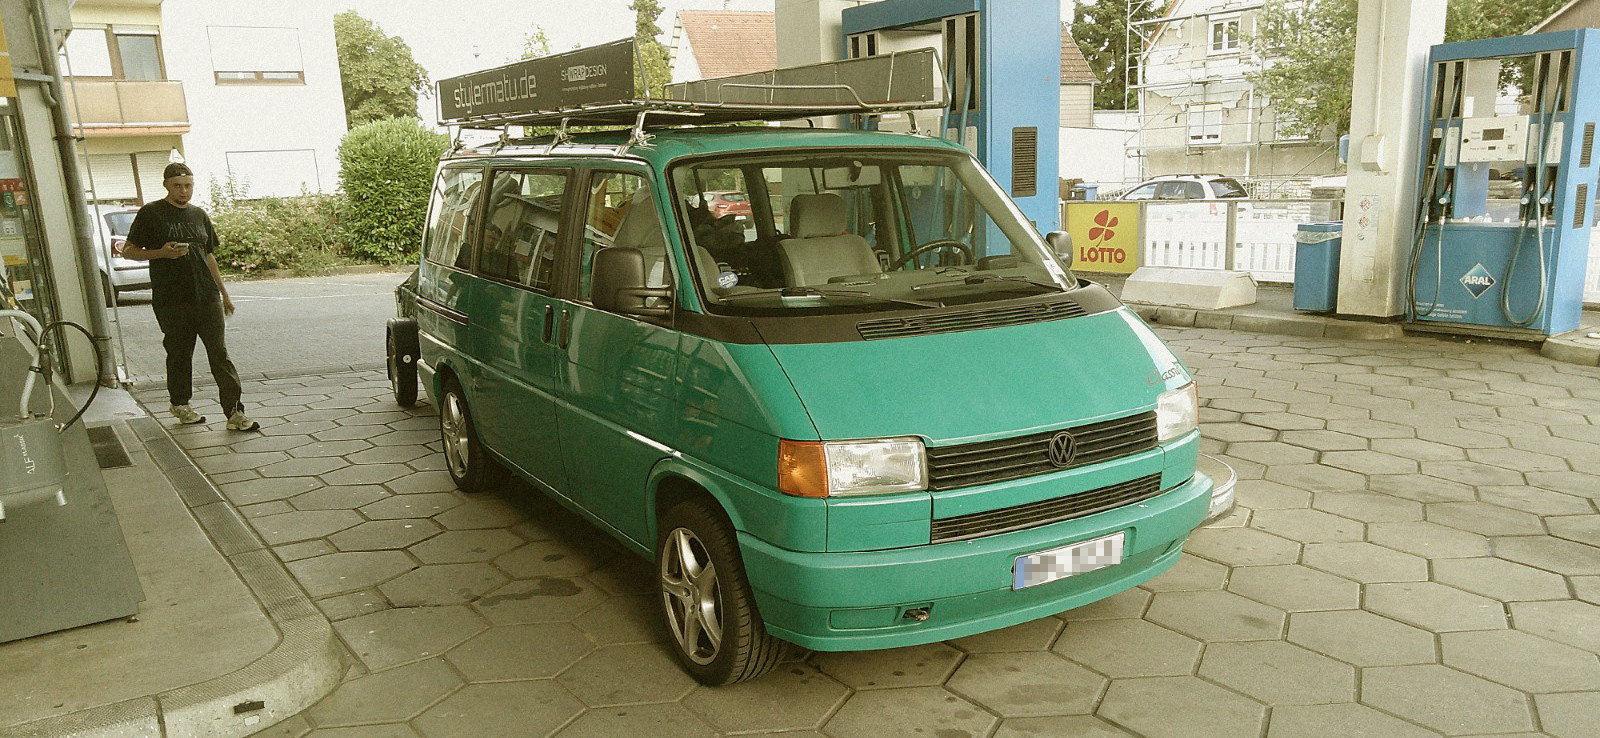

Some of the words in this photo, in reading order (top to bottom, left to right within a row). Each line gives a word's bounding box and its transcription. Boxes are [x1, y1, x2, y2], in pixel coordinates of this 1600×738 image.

[454, 69, 537, 114] stylermatu.de
[1080, 246, 1126, 264] LOTTO
[1464, 276, 1491, 286] ARAL
